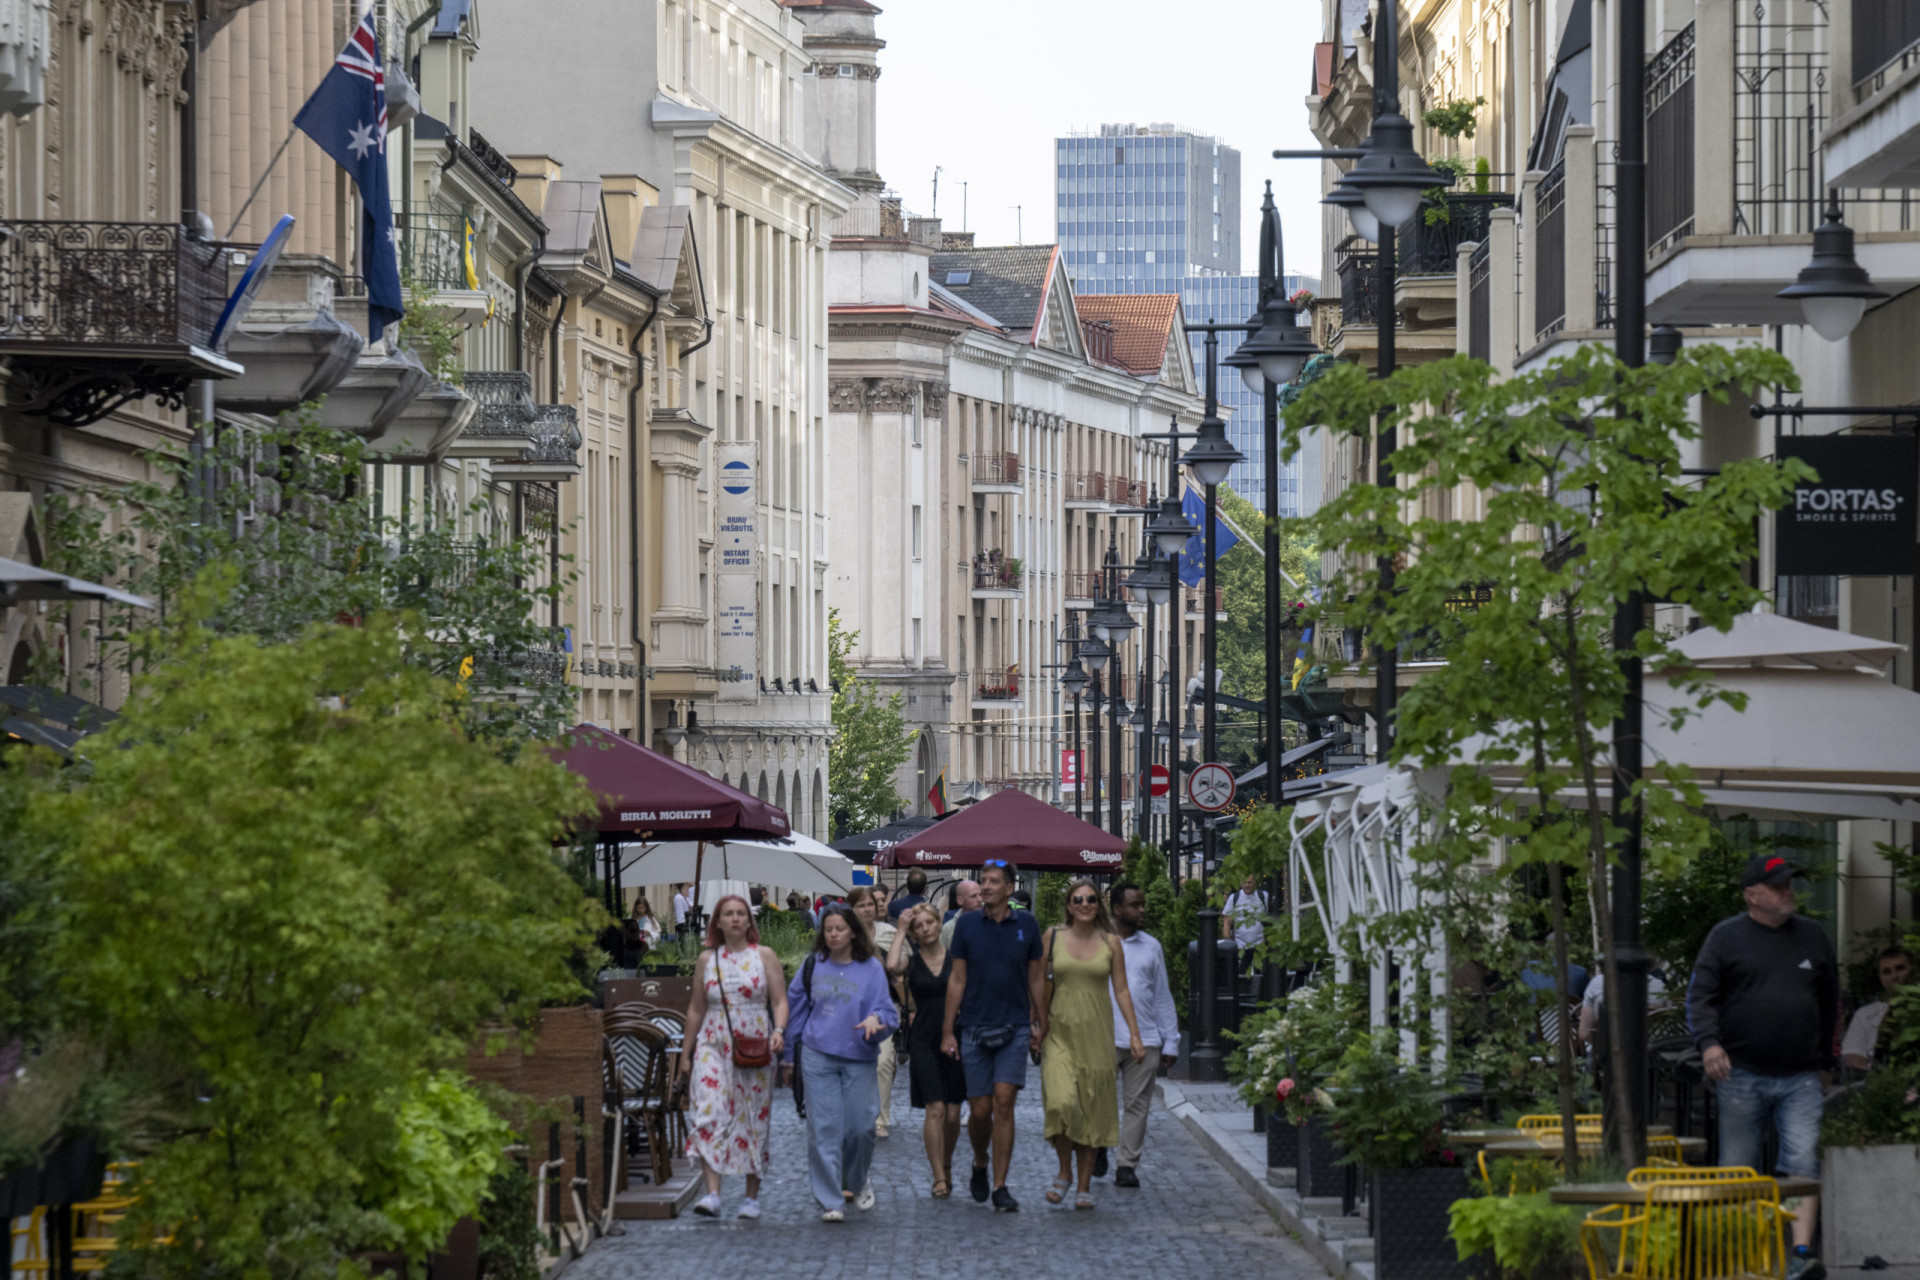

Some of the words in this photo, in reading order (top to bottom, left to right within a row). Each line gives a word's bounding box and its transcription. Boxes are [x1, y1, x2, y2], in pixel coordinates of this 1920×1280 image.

[1796, 513, 1835, 522] SMOKE
[1840, 513, 1847, 522] &
[1852, 513, 1896, 522] SPIRITS
[723, 549, 750, 557] INSTANT
[723, 558, 750, 566] OFFICES
[620, 812, 657, 822] BIRRA
[659, 810, 712, 820] MORETTI
